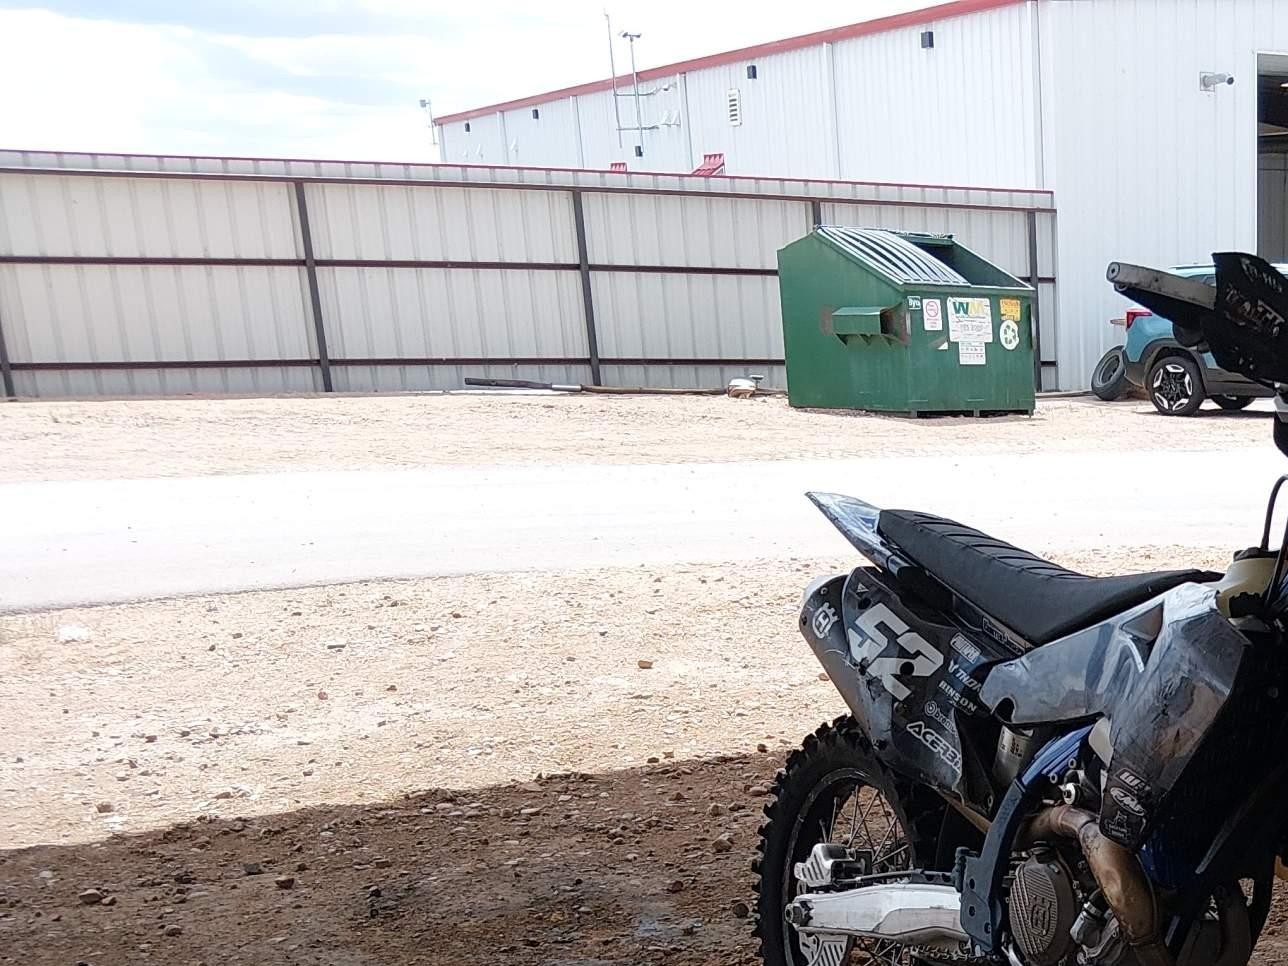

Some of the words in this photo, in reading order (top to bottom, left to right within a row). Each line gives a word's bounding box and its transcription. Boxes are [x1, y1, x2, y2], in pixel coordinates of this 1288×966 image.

[953, 301, 984, 315] WM
[848, 602, 944, 700] 52
[907, 721, 962, 773] ACERBI
